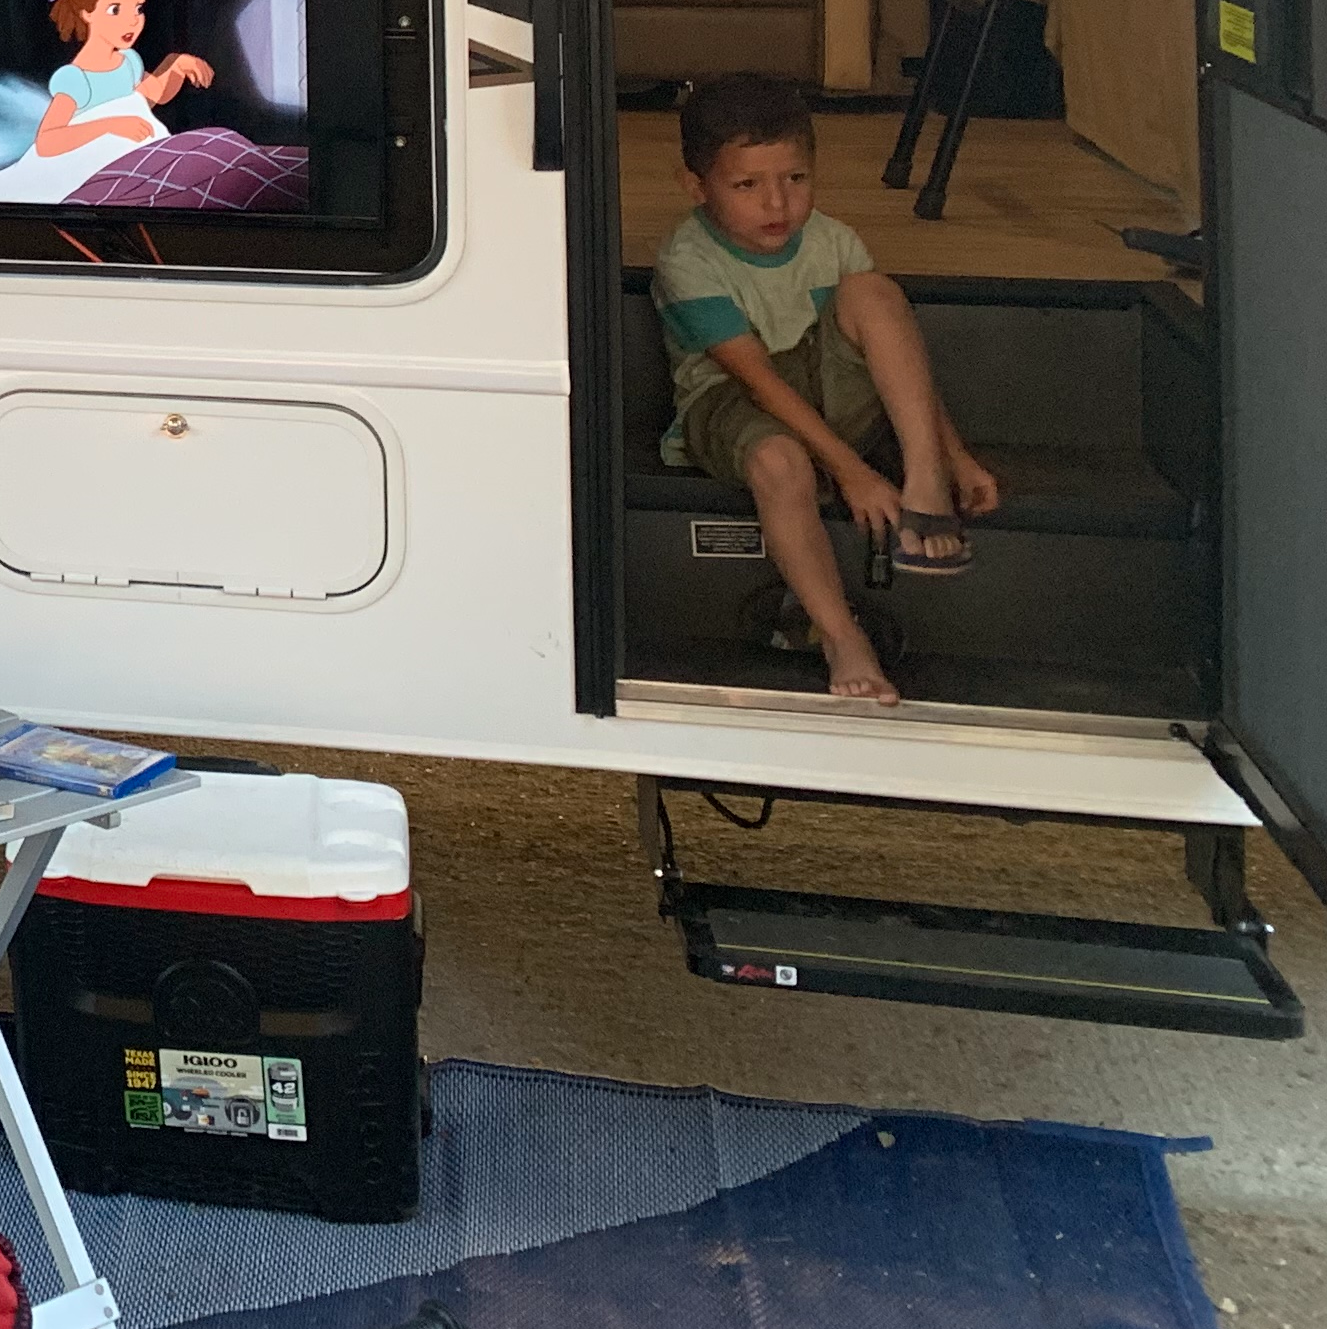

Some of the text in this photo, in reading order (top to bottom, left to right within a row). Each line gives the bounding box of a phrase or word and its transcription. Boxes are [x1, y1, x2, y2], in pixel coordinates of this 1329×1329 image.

[125, 1049, 155, 1059] TEXAS
[125, 1057, 156, 1067] MADE
[126, 1070, 156, 1079] SINCE
[214, 1071, 247, 1079] COOLER
[127, 1078, 157, 1089] 1947
[272, 1082, 296, 1094] 42
